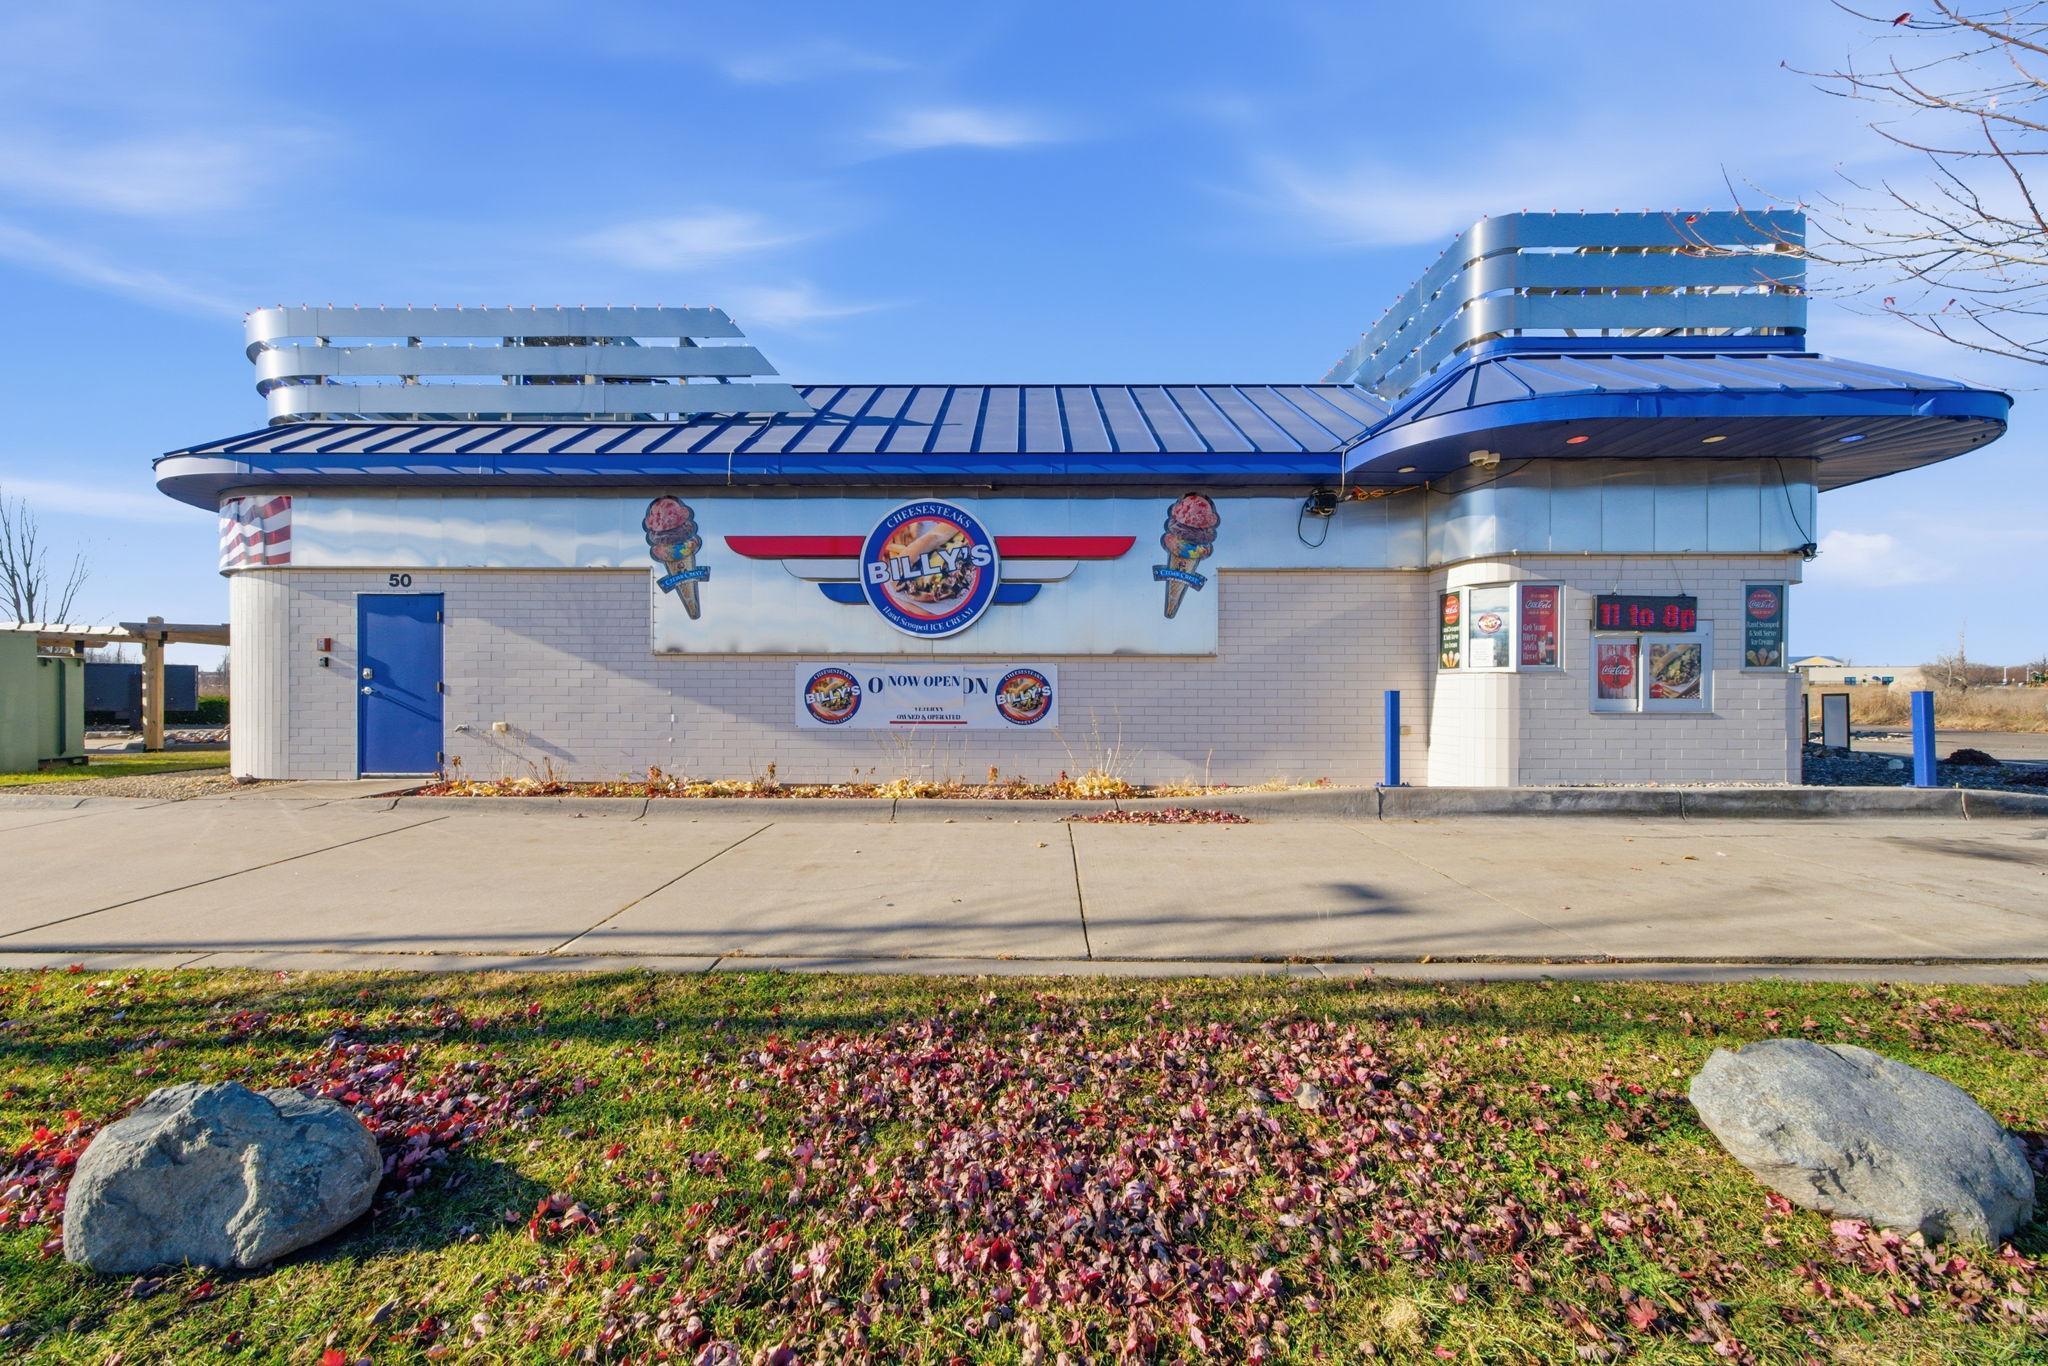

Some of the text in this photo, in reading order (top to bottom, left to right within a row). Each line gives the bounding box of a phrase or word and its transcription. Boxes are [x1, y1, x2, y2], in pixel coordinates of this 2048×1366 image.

[886, 505, 972, 529] CHEESESTEAKS
[867, 544, 992, 585] BILLY'S
[389, 573, 412, 588] 50
[901, 617, 929, 632] Scooped
[930, 620, 945, 631] ICE
[945, 607, 974, 628] CREAM
[1629, 604, 1655, 627] to
[888, 675, 961, 687] NOW OPEN
[806, 685, 860, 704] BILLY'S
[996, 685, 1051, 705] BILLY'S
